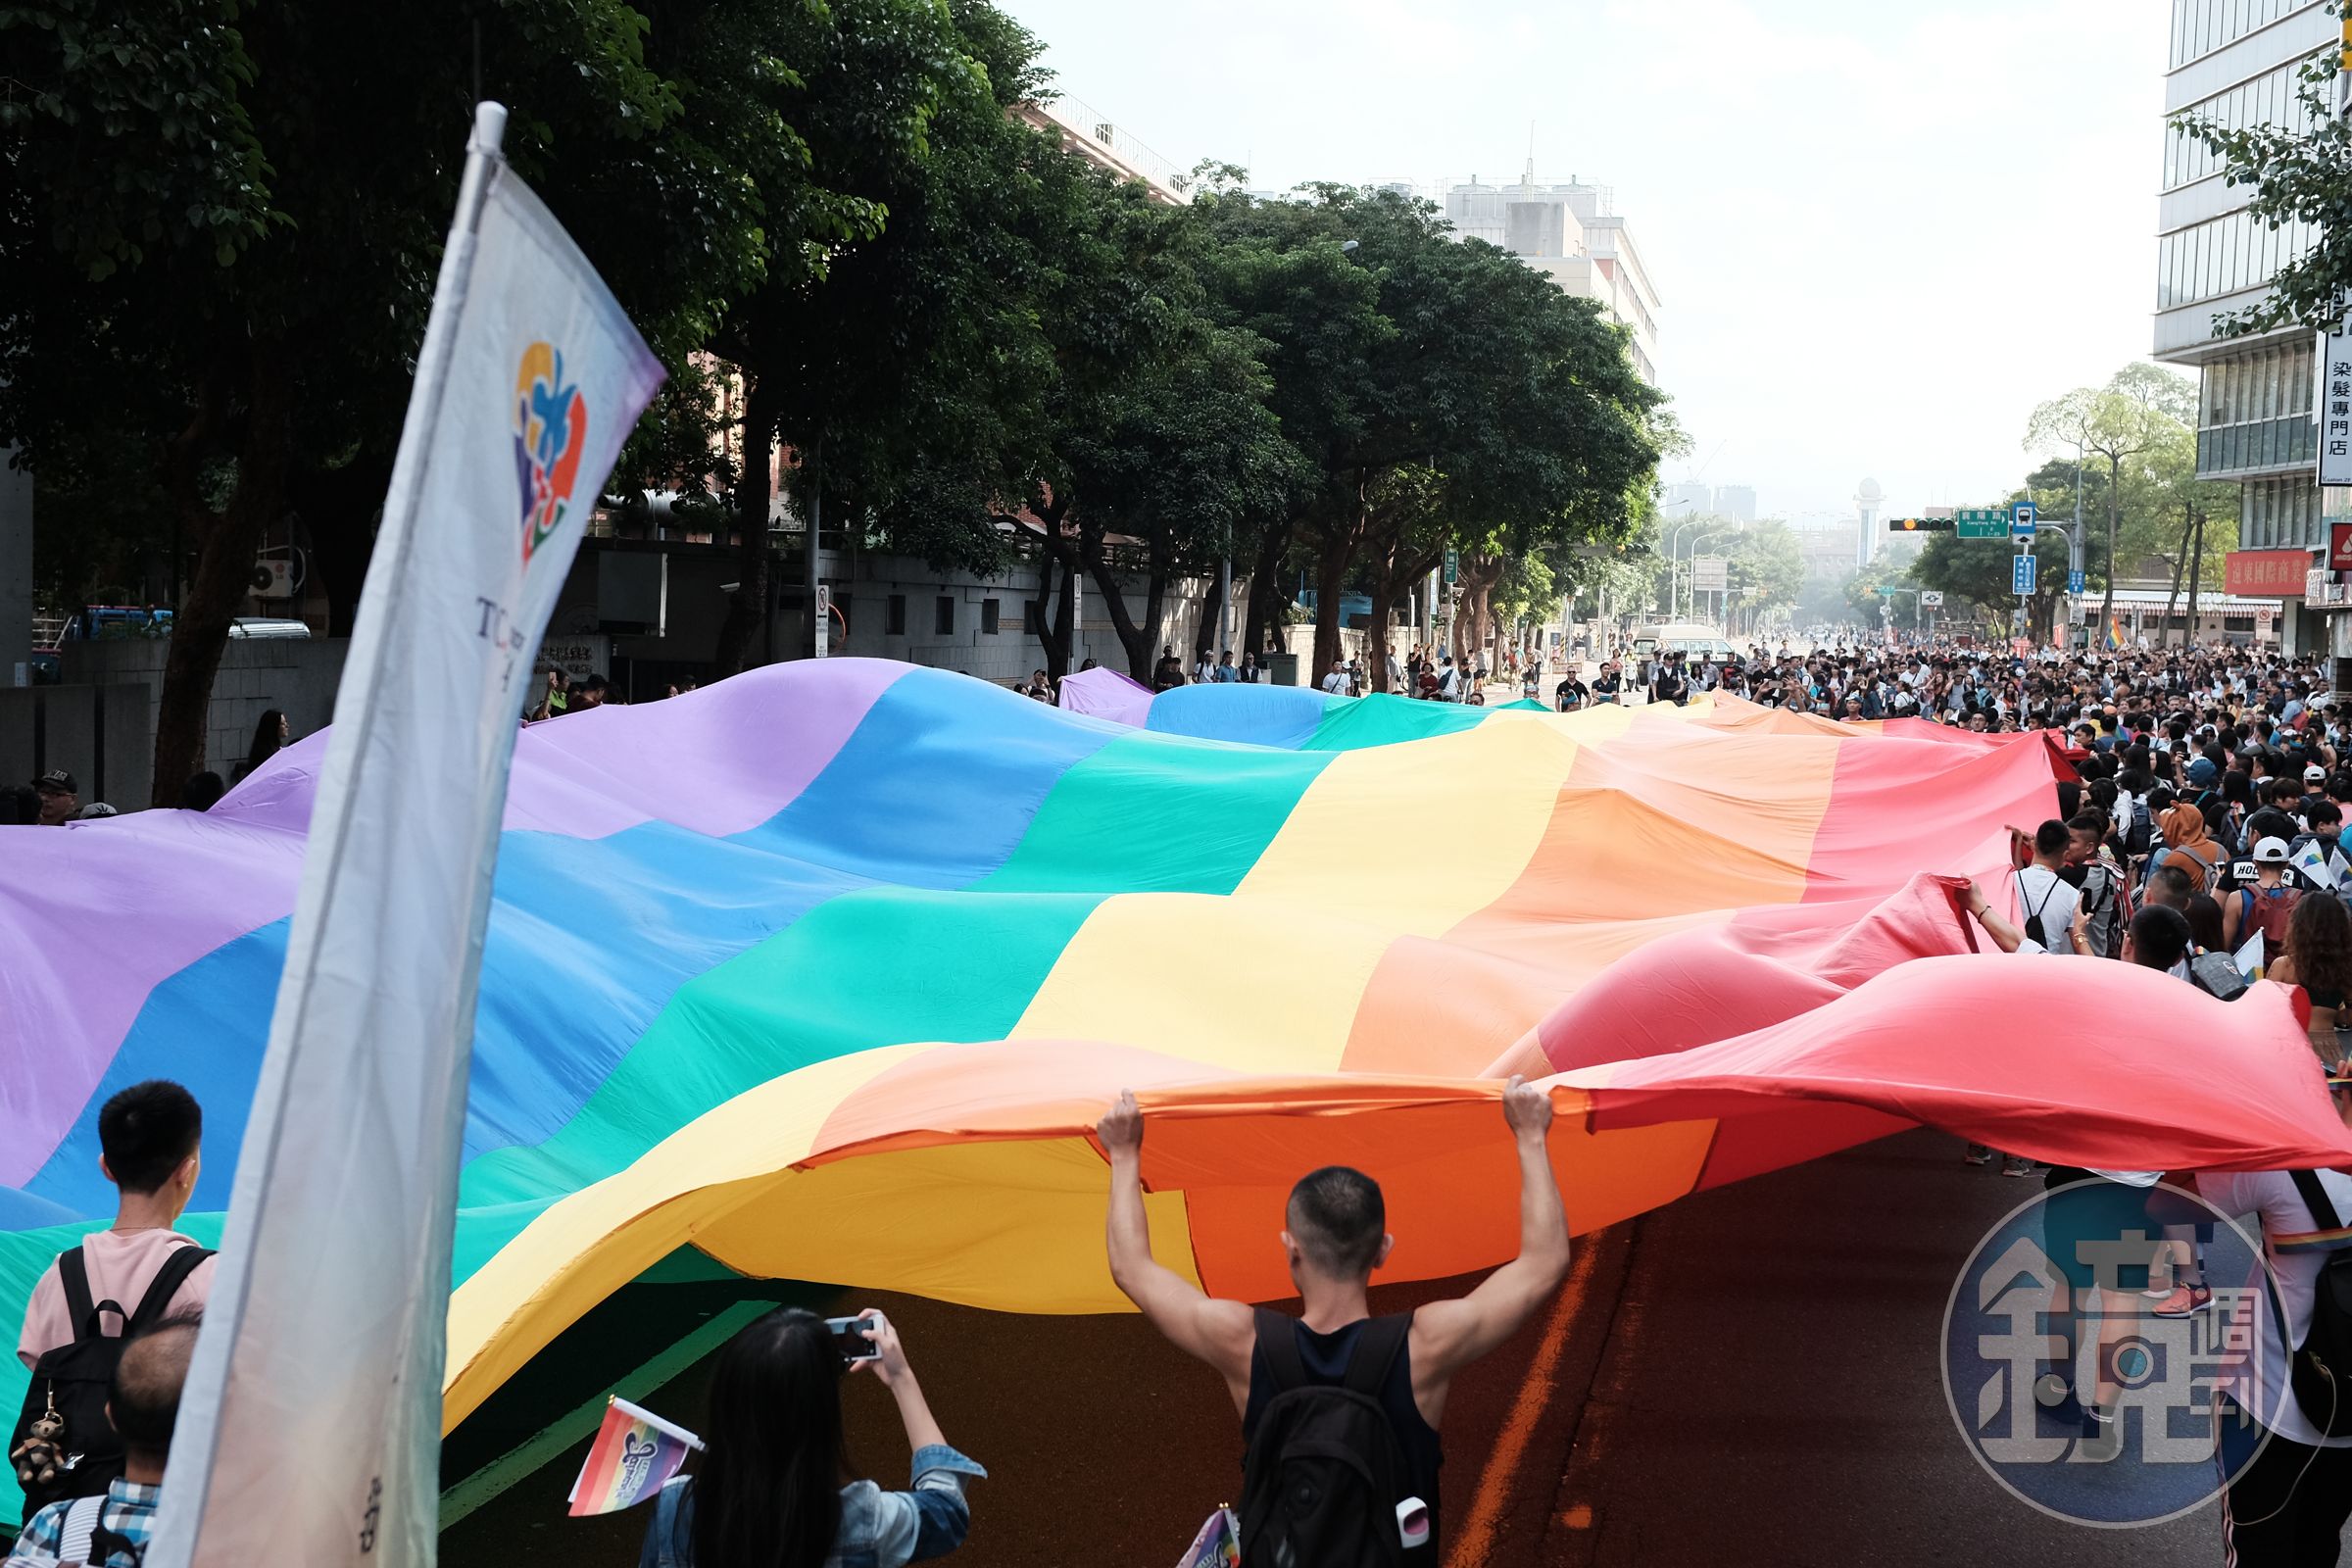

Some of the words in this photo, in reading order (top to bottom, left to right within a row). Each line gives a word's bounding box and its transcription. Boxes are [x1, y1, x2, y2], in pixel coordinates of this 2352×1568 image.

[2328, 362, 2352, 456] 染髮專門店
